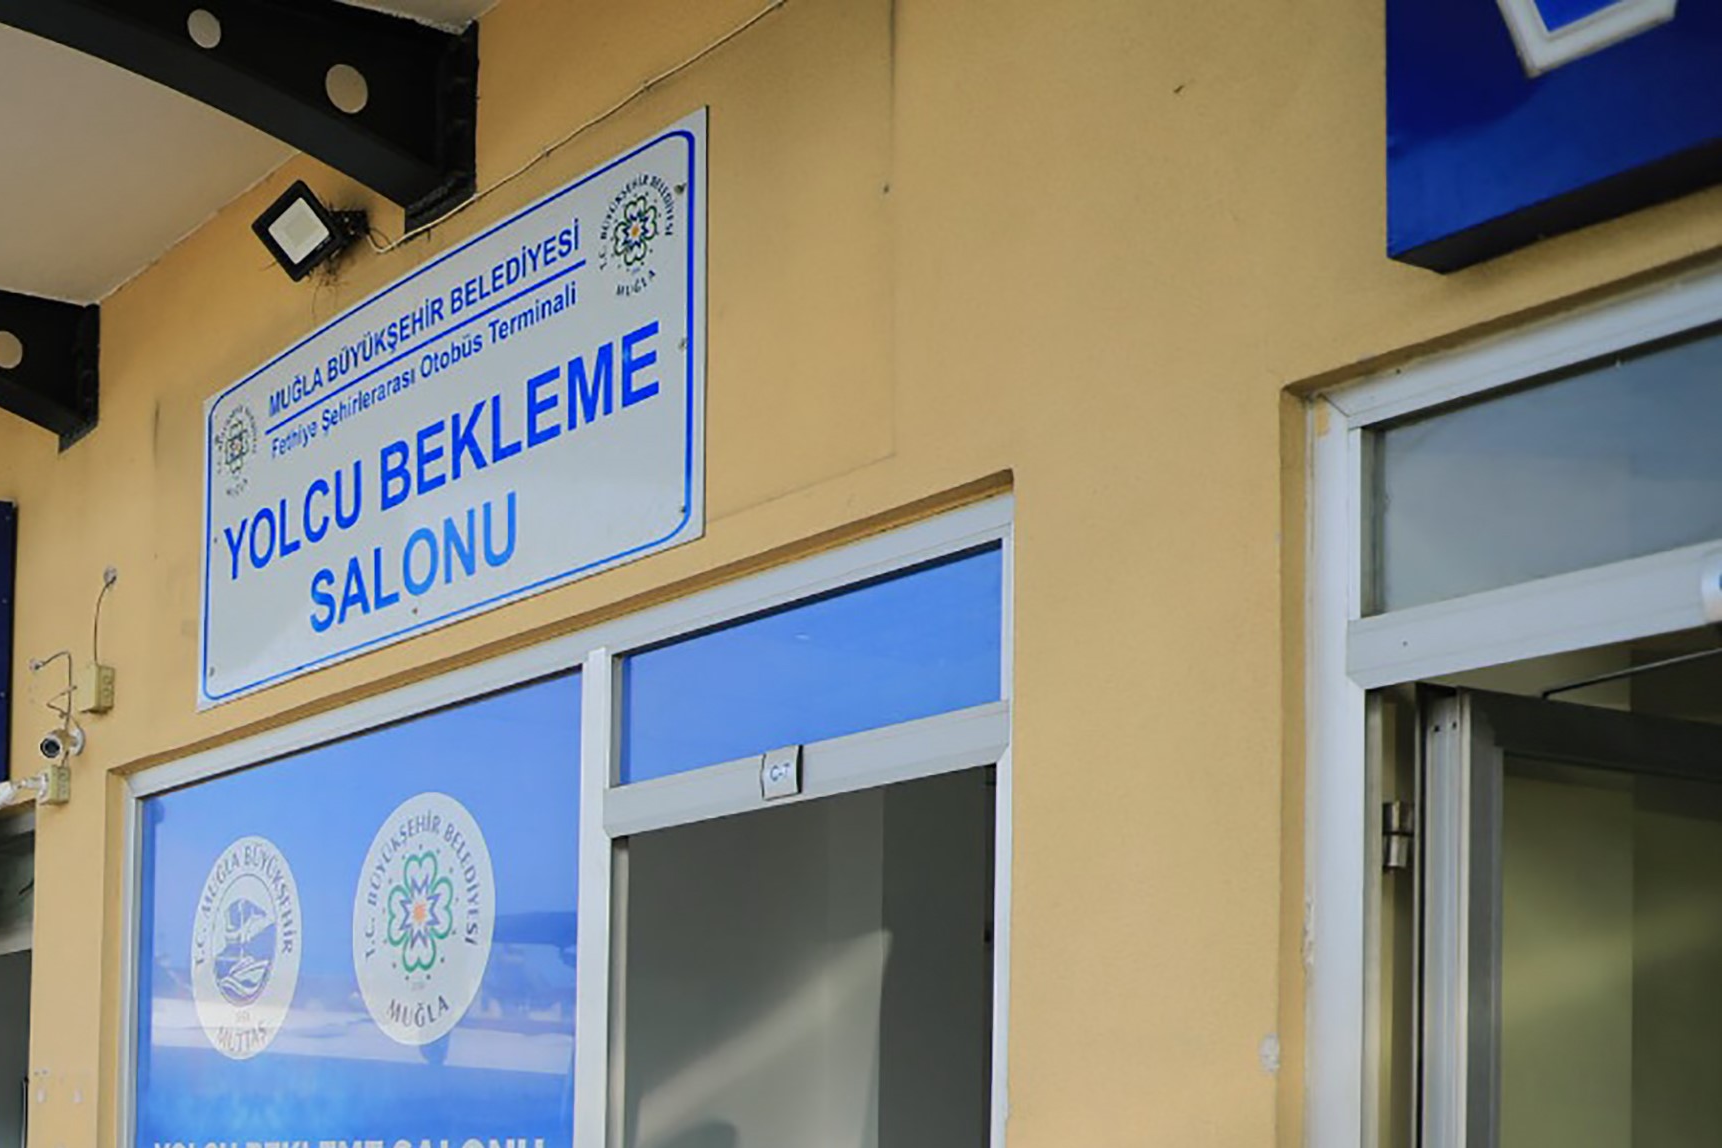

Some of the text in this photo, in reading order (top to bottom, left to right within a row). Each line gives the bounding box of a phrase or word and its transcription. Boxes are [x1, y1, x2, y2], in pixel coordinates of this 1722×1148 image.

[269, 218, 580, 417] MUĞLA BÜYÜKŞEHİR BELEDİYESİ
[271, 418, 317, 459] Fethiye
[322, 368, 416, 436] Şehirlerarası
[420, 332, 483, 379] Otobüs
[488, 282, 577, 344] Terminali
[223, 460, 363, 581] YOLCU
[380, 321, 660, 512] BEKLEME
[309, 491, 518, 634] SALONU
[368, 808, 442, 910] BÜYÜKŞEHİR
[443, 822, 480, 947] BELEDİYESİ
[387, 993, 450, 1030] MUĞLA
